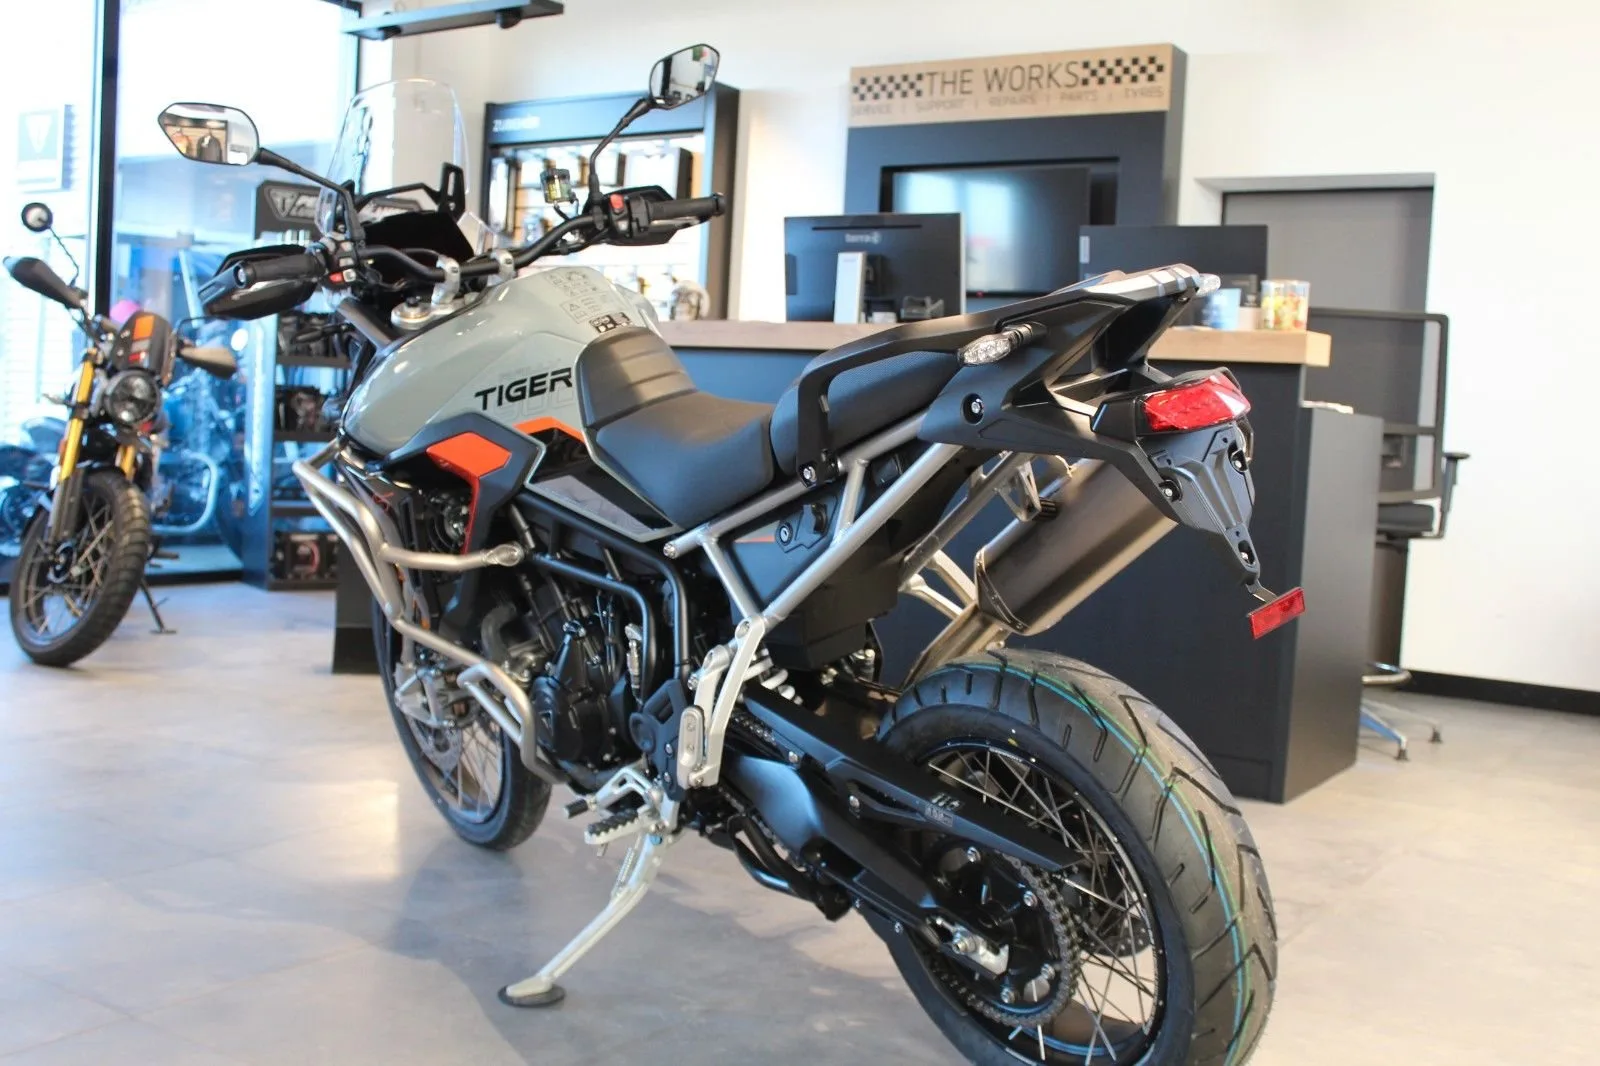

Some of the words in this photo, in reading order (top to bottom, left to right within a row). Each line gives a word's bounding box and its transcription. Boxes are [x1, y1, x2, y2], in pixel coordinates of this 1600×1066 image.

[925, 70, 974, 96] THE
[984, 61, 1080, 91] WORKS
[474, 367, 573, 411] TIGER
